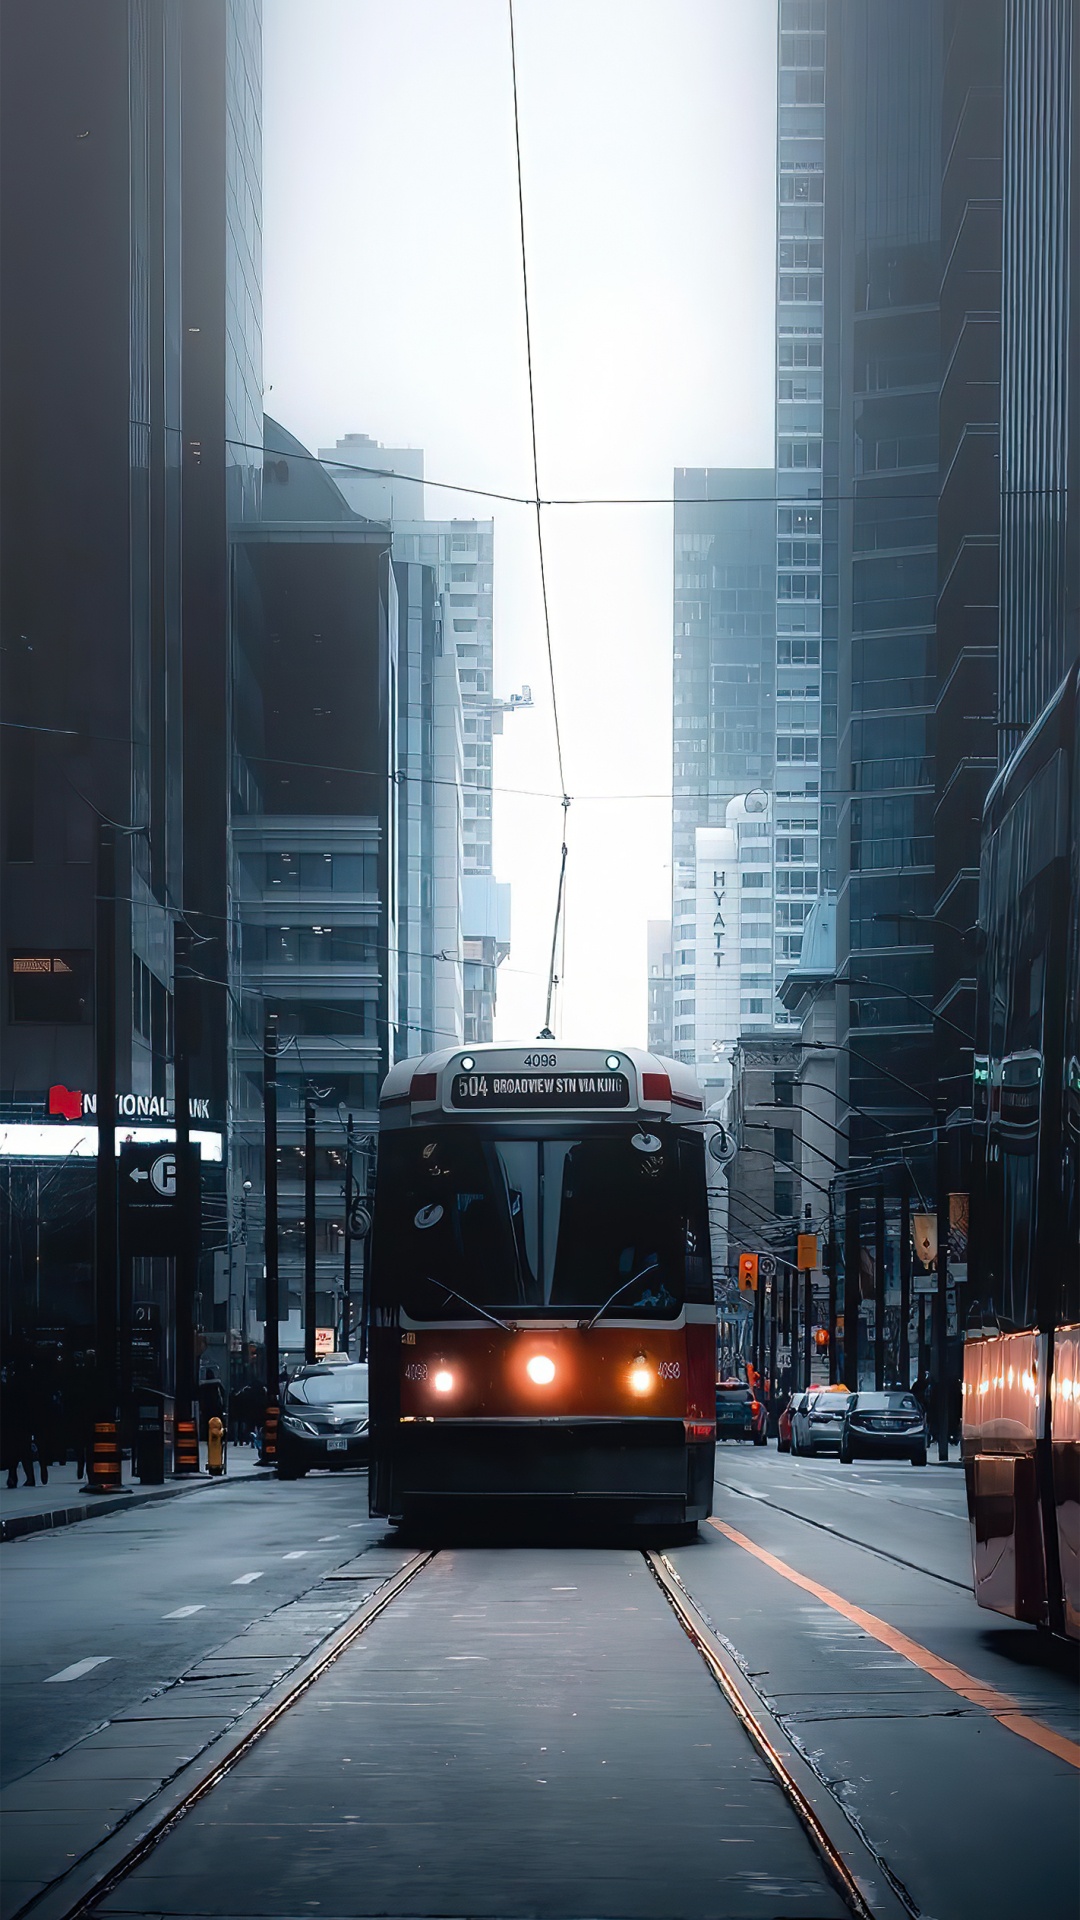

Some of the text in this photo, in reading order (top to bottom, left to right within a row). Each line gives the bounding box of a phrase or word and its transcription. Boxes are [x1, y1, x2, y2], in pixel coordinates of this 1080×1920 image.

[713, 870, 726, 968] HYATT
[459, 1076, 488, 1097] 504
[493, 1078, 554, 1094] BROADVIEW
[556, 1078, 576, 1093] STN
[578, 1078, 596, 1093] VIA
